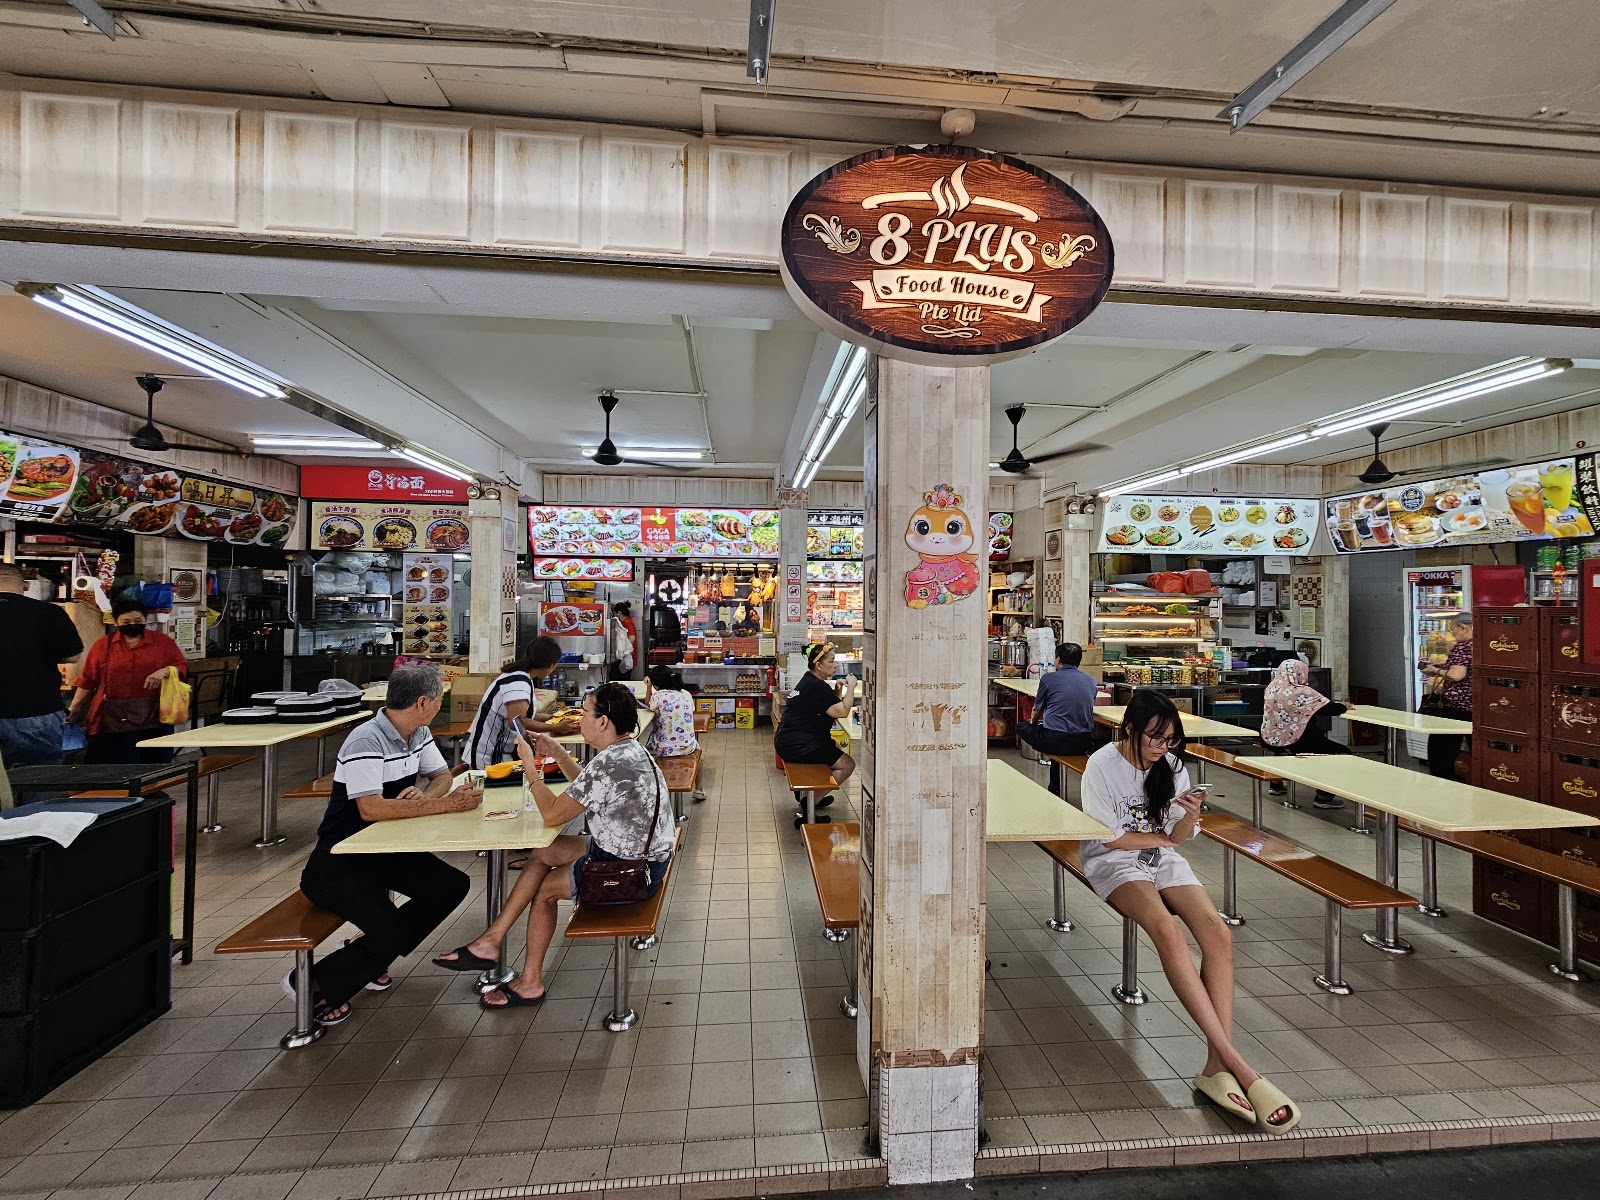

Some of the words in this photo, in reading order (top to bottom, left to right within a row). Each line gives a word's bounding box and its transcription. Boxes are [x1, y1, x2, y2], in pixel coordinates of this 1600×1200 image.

[869, 212, 913, 266] 8
[921, 218, 1038, 273] PLUS
[896, 275, 946, 294] Food
[950, 276, 1010, 300] House
[918, 301, 950, 320] Pte
[952, 303, 984, 326] Ltd
[1419, 571, 1450, 580] POKKA
[1489, 640, 1519, 652] Carlsberg
[1561, 703, 1597, 727] Carlsberg
[1489, 767, 1520, 783] Carlsberg
[1562, 781, 1598, 798] Carlsberg
[1491, 892, 1521, 911] Carlsberg
